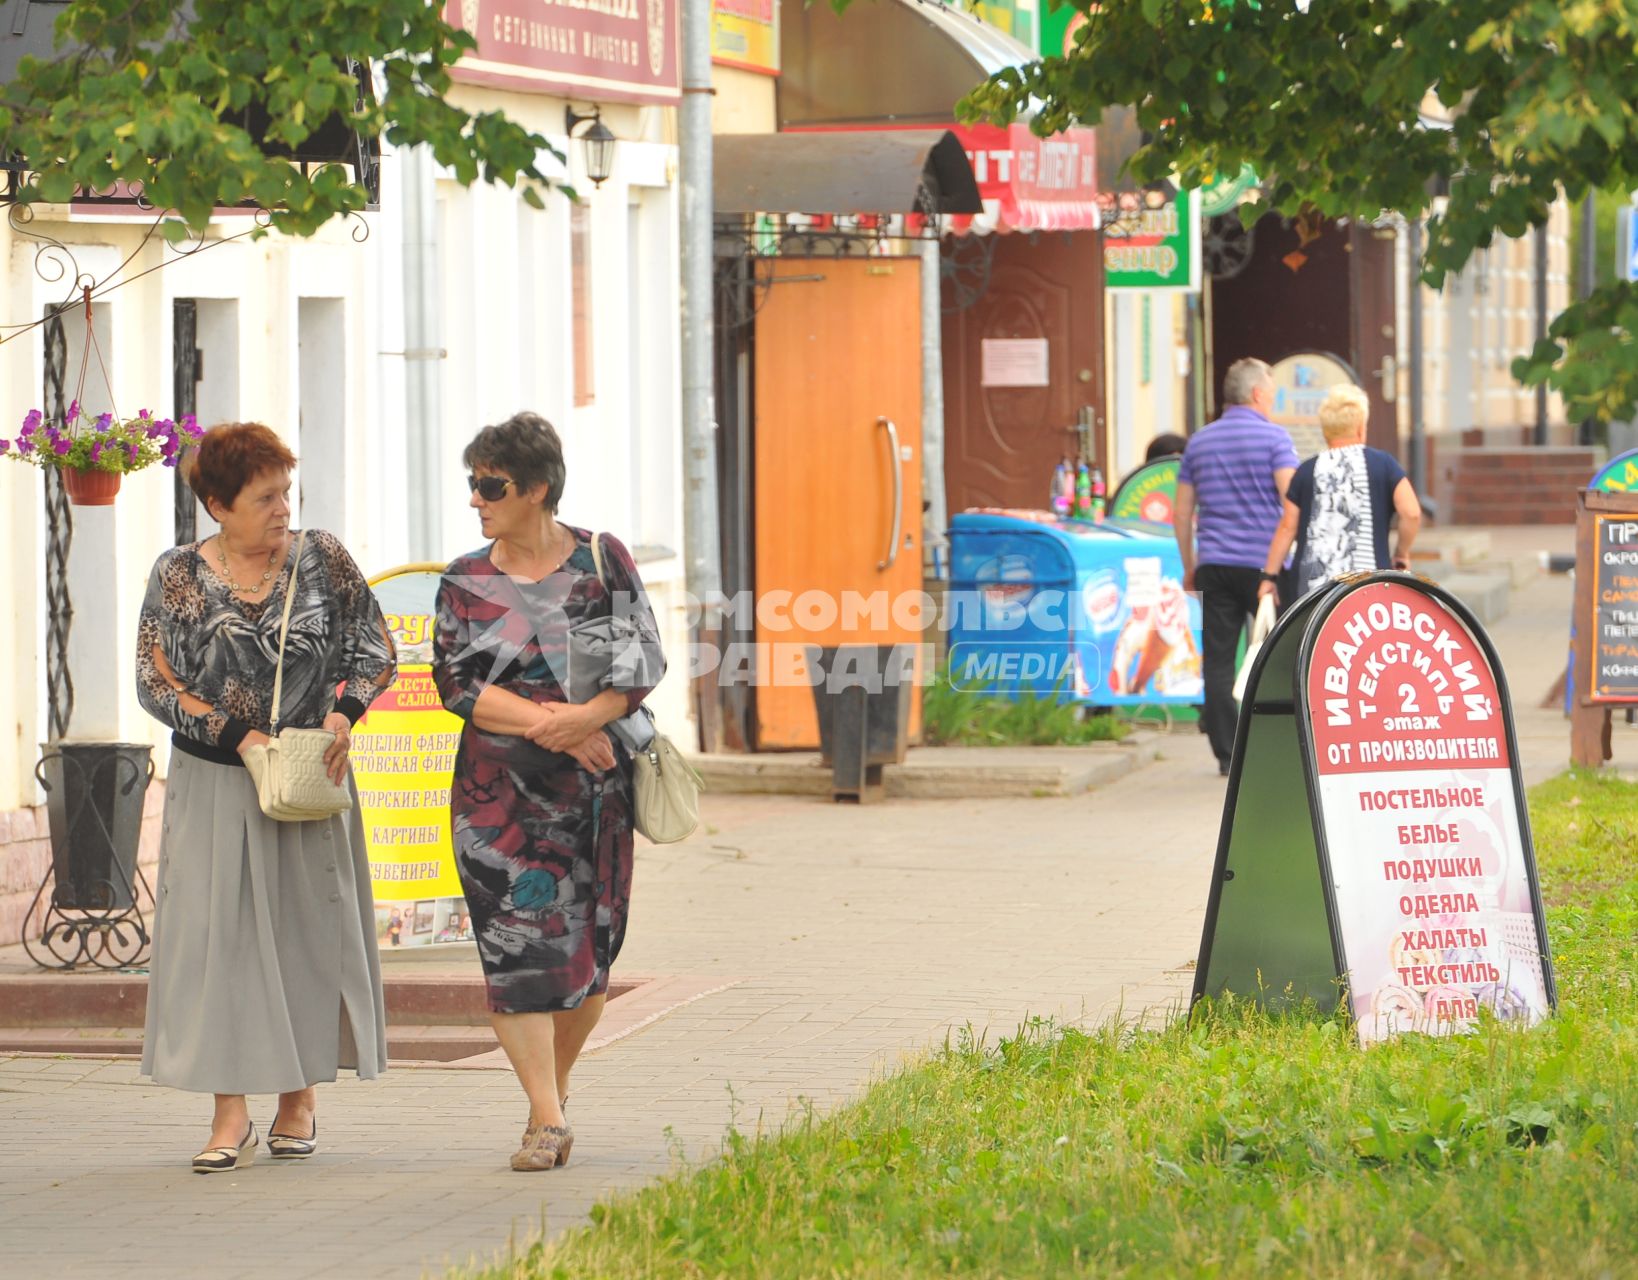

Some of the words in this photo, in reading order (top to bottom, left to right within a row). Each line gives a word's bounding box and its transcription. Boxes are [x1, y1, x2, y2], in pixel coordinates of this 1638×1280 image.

[1324, 601, 1492, 726] ИВАНОВСКИЙ
[1357, 641, 1454, 719] ТЕКСТИЛЬ
[1397, 683, 1420, 713] 2
[1383, 716, 1441, 731] этаж
[1327, 743, 1350, 764] ОТ
[1358, 737, 1498, 763] ПРОИЗВОДИТЕЛЯ
[422, 754, 455, 772] ФИН
[1359, 787, 1484, 811] ПОСТЕЛЬНОЕ
[373, 826, 439, 845] КАРТИНЫ
[1397, 823, 1460, 845] БЕЛЬЕ
[1384, 857, 1482, 883] ПОДУШКИ
[1400, 893, 1479, 918] ОДЕЯЛА
[1401, 927, 1487, 951] ХАЛАТЫ
[1397, 962, 1500, 987] ТЕКСТИЛЬ
[1436, 999, 1478, 1023] ДЛЯ
